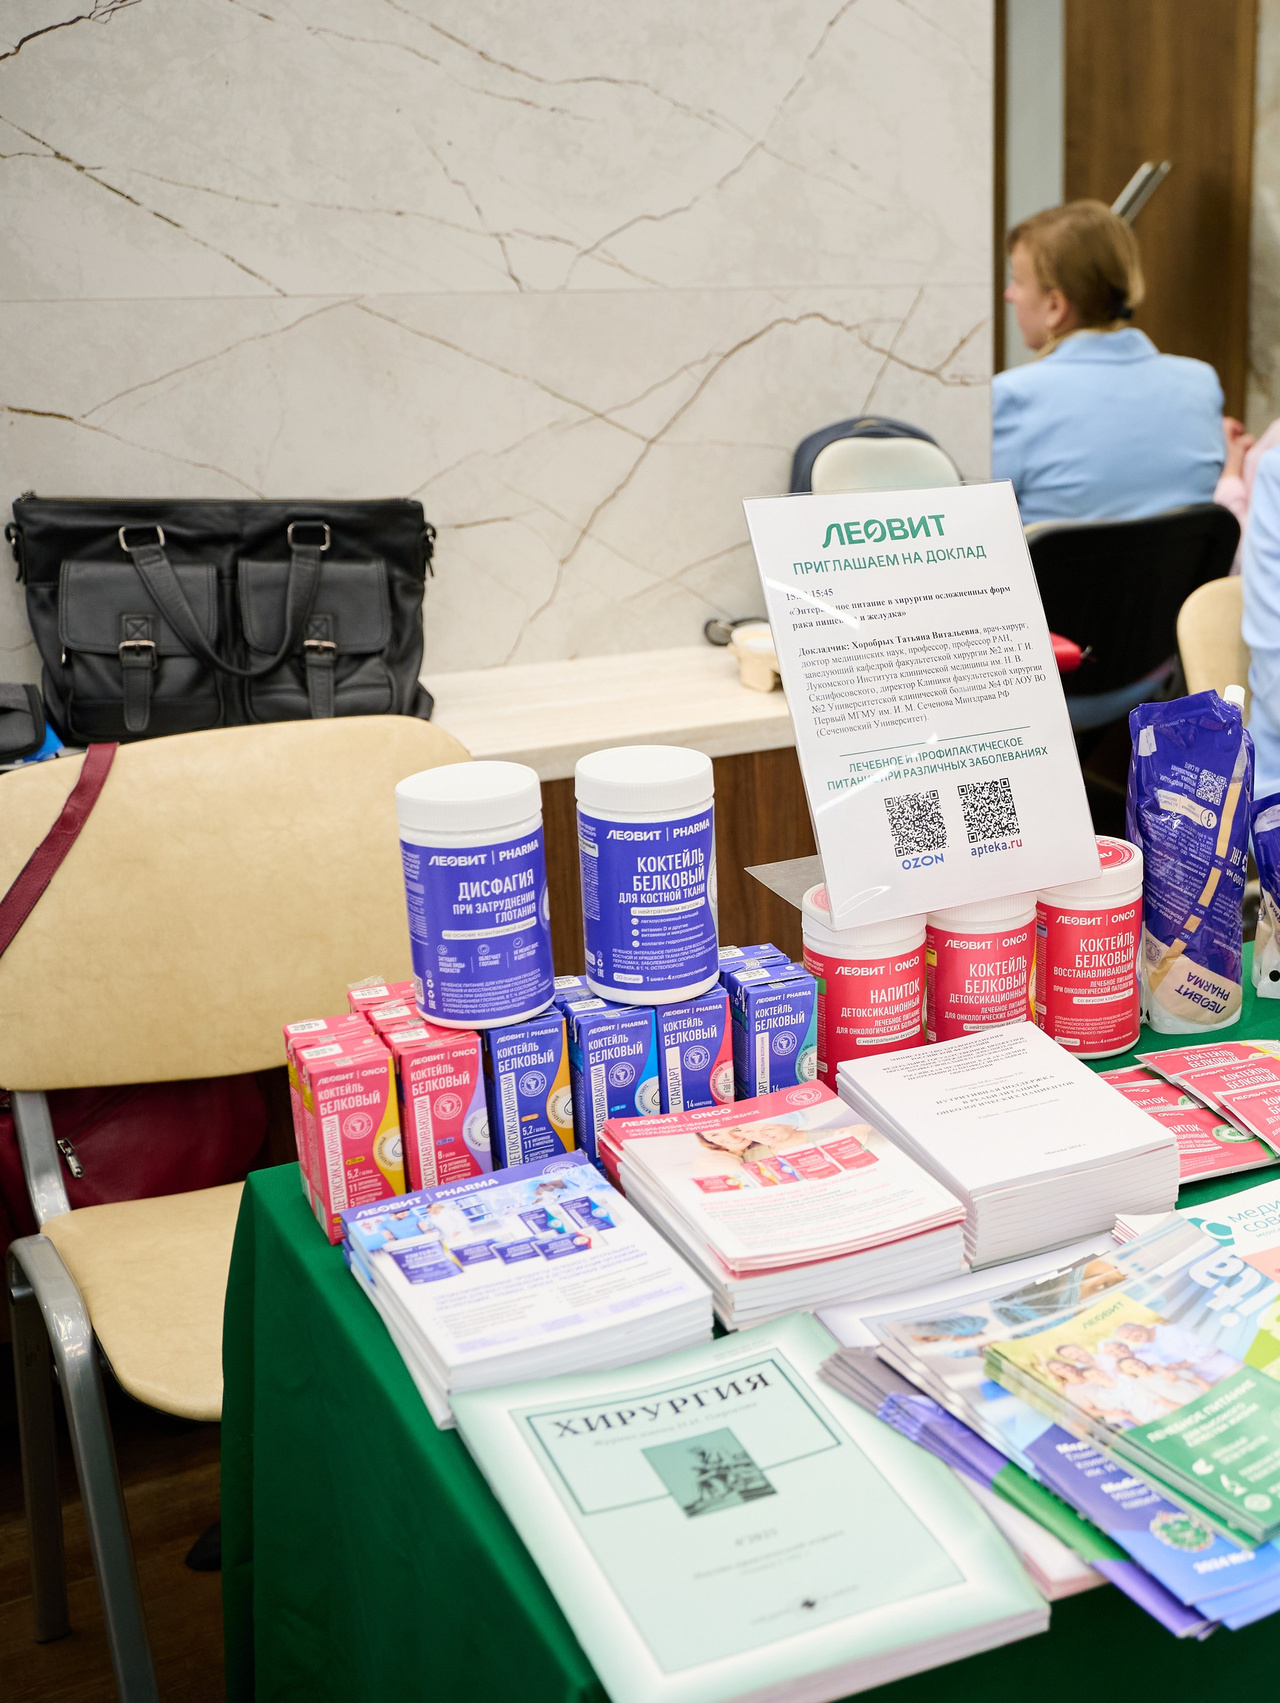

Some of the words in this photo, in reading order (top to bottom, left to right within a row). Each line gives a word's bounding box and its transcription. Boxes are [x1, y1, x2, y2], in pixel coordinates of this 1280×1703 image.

[822, 514, 945, 549] ЛЕОВИТ
[793, 554, 900, 575] ПРИГЛАШАЕМ
[903, 551, 923, 565] НА
[926, 545, 987, 564] ДОКЛАД
[851, 600, 886, 610] питание
[894, 594, 934, 605] хирургии
[934, 589, 989, 601] осложненных
[989, 586, 1011, 595] форм
[792, 621, 814, 631] рака
[867, 611, 907, 621] желудка»
[798, 643, 850, 657] Докладчик:
[851, 637, 895, 650] Хоробрых
[895, 633, 931, 645] Татьяна
[932, 627, 982, 640] Витальевна,
[983, 621, 1029, 634] врач-хирург,
[801, 658, 830, 669] доктор
[831, 652, 885, 663] медицинских
[886, 649, 907, 658] наук,
[908, 643, 951, 655] профессор,
[952, 637, 992, 650] профессор
[992, 633, 1013, 643] РАН,
[804, 665, 855, 679] заведующий
[856, 659, 894, 673] кафедрой
[895, 653, 952, 669] факультетской
[953, 649, 988, 661] хирургии
[989, 646, 1002, 656] №2
[806, 679, 855, 691] Лукомского
[857, 672, 898, 684] Института
[900, 664, 949, 678] клинической
[950, 660, 989, 671] медицины
[808, 687, 878, 703] Склифосовского,
[879, 680, 916, 693] директор
[917, 677, 951, 687] Клиники
[952, 667, 1008, 683] факультетской
[1008, 664, 1043, 676] хирургии
[811, 703, 827, 714] №2
[828, 694, 897, 711] Университетской
[898, 688, 948, 702] клинической
[949, 683, 987, 694] больницы
[988, 679, 1001, 689] №4
[1002, 675, 1033, 687] ФГАОУ
[1035, 673, 1047, 682] ВО
[813, 714, 847, 726] Первый
[847, 709, 877, 721] МГМУ
[917, 699, 954, 711] Сеченова
[954, 692, 997, 705] Минздрава
[997, 689, 1010, 699] РФ
[815, 721, 873, 738] (Сеченовский
[873, 713, 930, 729] Университет).
[849, 756, 904, 773] ЛЕЧЕБНОЕ
[914, 737, 1024, 762] ПРОФИЛАКТИЧЕСКОЕ
[903, 759, 968, 778] РАЗЛИЧНЫХ
[969, 746, 1049, 768] ЗАБОЛЕВАНИЯХ
[606, 829, 662, 841] ЛЕОВИТ
[673, 818, 710, 839] PHARMA
[428, 853, 487, 867] ЛЕОВИТ
[498, 839, 540, 862] PHARMA
[970, 838, 1023, 858] apteka.ru
[637, 847, 705, 873] КОКТЕЙЛЬ
[901, 853, 945, 870] OZON
[458, 868, 534, 901] ДИСФАГИЯ
[632, 862, 705, 892] БЕЛКОВЫЙ
[453, 903, 473, 915] ПРИ
[475, 890, 536, 914] ЗАТРУДНЕНИИ
[618, 892, 638, 904] ДЛЯ
[640, 887, 681, 904] КОСТНОЙ
[683, 882, 706, 899] ТКАНИ
[495, 902, 537, 924] ГЛОТАНИЯ
[1056, 915, 1103, 926] ЛЕОВИТ
[1111, 909, 1135, 924] ONCO
[944, 939, 993, 950] ЛЕОВИТ
[1001, 932, 1028, 948] ONCO
[1080, 931, 1135, 952] КОКТЕЙЛЬ
[834, 966, 886, 976] ЛЕОВИТ
[894, 955, 920, 972] ONCO
[969, 955, 1027, 977] КОКТЕЙЛЬ
[1075, 944, 1134, 968] БЕЛКОВЫЙ
[1053, 960, 1134, 978] ВОССТАНАВЛИВАЮЩИЙ
[870, 978, 920, 1004] НАПИТОК
[965, 968, 1027, 994] БЕЛКОВЫЙ
[1053, 985, 1064, 993] ПРИ
[1064, 985, 1111, 995] ОНКОЛОГИЧЕСКОЙ
[1111, 979, 1134, 991] ПАТОЛОГИИ
[1089, 978, 1116, 988] ЛЕЧЕБНОЕ
[1186, 971, 1231, 1001] PHARMA
[786, 990, 811, 999] PHARMA
[949, 984, 1027, 1005] ДЕТОКСИКАЦИОННЫЙ
[1174, 984, 1226, 1015] ЛЕОВИТ
[662, 1008, 690, 1018] ЛЕОВИТ
[695, 1003, 722, 1014] PHARMA
[755, 1004, 792, 1018] КОКТЕЙЛЬ
[840, 995, 920, 1018] ДЕТОКСИКАЦИОННЫЙ
[944, 1011, 956, 1019] ДЛЯ
[956, 1011, 1006, 1022] ОНКОЛОГИЧЕСКИХ
[980, 1004, 1008, 1014] ЛЕЧЕБНОЕ
[620, 1019, 649, 1030] PHARMA
[663, 1017, 703, 1033] КОКТЕЙЛЬ
[755, 1011, 805, 1032] БЕЛКОВЫЙ
[835, 1026, 849, 1034] ДЛЯ
[849, 1024, 901, 1035] ОНКОЛОГИЧЕСКИХ
[874, 1015, 902, 1027] ЛЕЧЕБНОЕ
[530, 1027, 560, 1038] PHARMA
[588, 1034, 629, 1051] КОКТЕЙЛЬ
[664, 1024, 717, 1047] БЕЛКОВЫЙ
[410, 1052, 445, 1067] ЛЕОВИТ
[452, 1048, 477, 1059] ONCO
[497, 1042, 539, 1060] КОКТЕЙЛЬ
[498, 1048, 554, 1074] БЕЛКОВЫЙ
[589, 1041, 644, 1065] БЕЛКОВЫЙ
[1183, 1049, 1234, 1062] КОКТЕЙЛЬ
[410, 1063, 454, 1082] КОКТЕЙЛЬ
[1188, 1056, 1239, 1069] БЕЛКОВЫЙ
[317, 1072, 354, 1086] ЛЕОВИТ
[361, 1066, 388, 1078] ONCO
[411, 1070, 470, 1097] БЕЛКОВЫЙ
[1219, 1067, 1271, 1082] КОКТЕЙЛЬ
[1226, 1073, 1279, 1090] БЕЛКОВЫЙ
[317, 1083, 365, 1101] КОКТЕЙЛЬ
[669, 1066, 681, 1106] СТАНДАРТ
[319, 1090, 381, 1116] БЕЛКОВЫЙ
[686, 1100, 694, 1109] 14
[503, 1075, 523, 1166] ДЕТОКСИКАЦИОННЫЙ
[620, 1116, 678, 1129] ЛЕОВИТ
[691, 1107, 732, 1119] ONCO
[625, 1119, 721, 1134] СПЕЦИАЛИЗИРОВАННОЕ
[721, 1109, 761, 1122] ЛЕЧЕБНОЕ
[522, 1125, 534, 1137] 5,2
[628, 1128, 685, 1138] ЭНТЕРАЛЬНОЕ
[685, 1123, 722, 1132] ПИТАНИЕ
[523, 1139, 532, 1150] 11
[322, 1117, 349, 1212] ДЕТОКСИКАЦИОННЫЙ
[346, 1168, 359, 1180] 5,2
[438, 1163, 448, 1174] 12
[348, 1183, 358, 1193] 11
[355, 1196, 422, 1219] ЛЕОВИТ
[435, 1178, 499, 1199] PHARMA
[551, 1372, 773, 1438] ХИРУРГИЯ
[1202, 1378, 1257, 1416] ПИТАНИЕ
